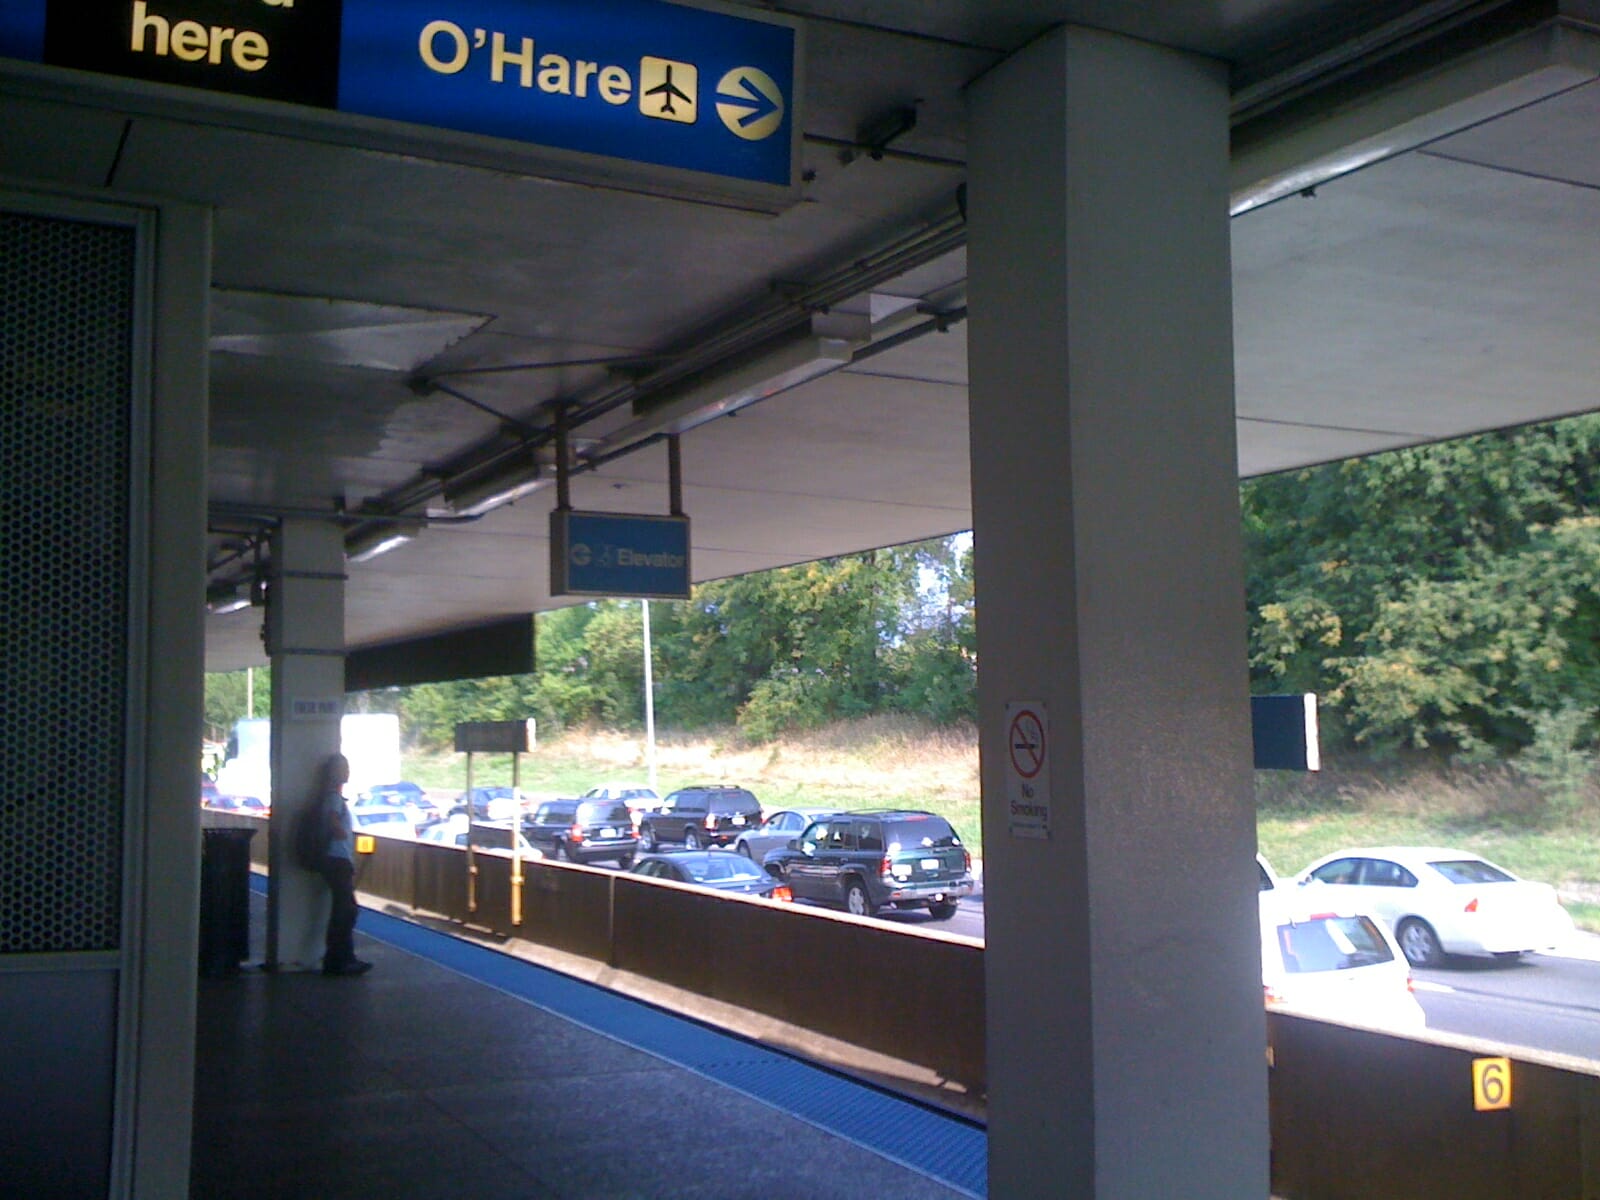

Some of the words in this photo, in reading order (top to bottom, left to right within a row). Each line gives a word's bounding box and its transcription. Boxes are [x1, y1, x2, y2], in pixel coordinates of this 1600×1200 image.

[131, 1, 269, 72] here
[418, 19, 632, 106] O'Hare
[617, 548, 685, 568] Elevator
[1021, 783, 1034, 798] No
[1010, 799, 1048, 821] Smoking
[1482, 1064, 1504, 1104] 6
